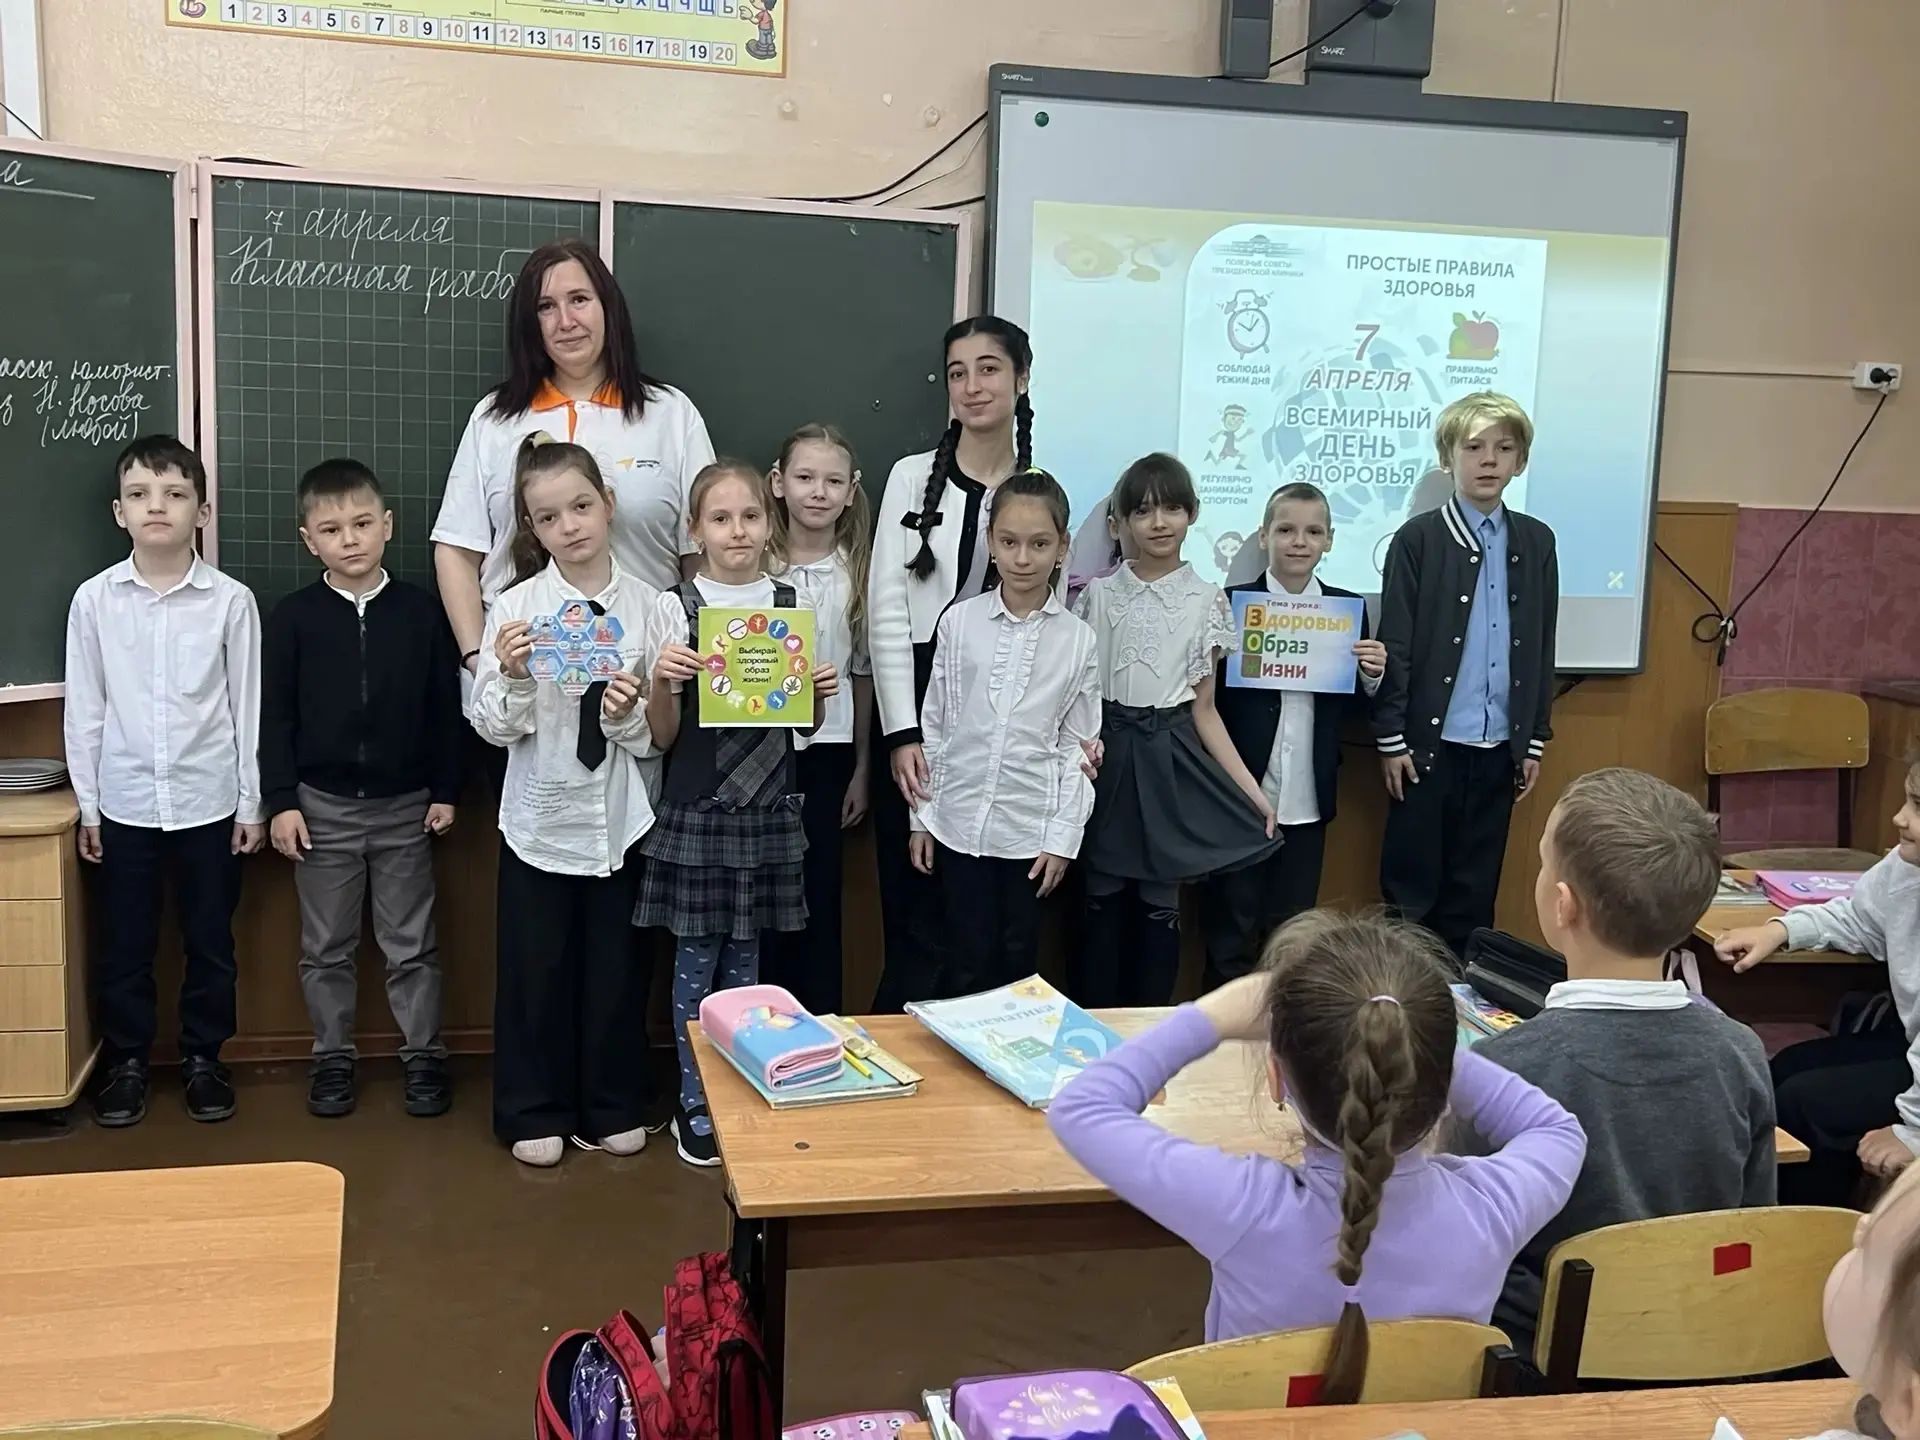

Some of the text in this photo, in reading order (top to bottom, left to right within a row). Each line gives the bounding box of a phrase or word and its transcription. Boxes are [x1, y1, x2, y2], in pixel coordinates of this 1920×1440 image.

[228, 4, 733, 61] 1 2 3 4 5 6 7 8 9 10 11 12 13 14 15 16 17 18 19 20
[265, 207, 454, 260] 7 апреля
[229, 235, 415, 292] Классная
[1347, 254, 1515, 278] ПРОСТЫЕ ПРАВИЛА
[1383, 279, 1475, 298] ЗДОРОВЬЯ
[1355, 324, 1380, 361] 7
[1217, 364, 1270, 374] СОБЛЮДАЙ
[1445, 365, 1498, 375] ПРАВИЛЬНО
[1216, 376, 1270, 386] РЕЖИМ ДНЯ
[1306, 369, 1412, 392] АПРЕЛЯ
[1450, 375, 1492, 385] ПИТАЙСЯ
[69, 380, 151, 416] Носова
[1286, 407, 1432, 429] ВСЕМИРНЫЙ
[1318, 434, 1396, 461] ДЕНЬ
[1295, 464, 1415, 485] ЗДОРОВЬЯ
[1203, 496, 1248, 505] СПОРТОМ
[1266, 600, 1322, 610] Тема урока:
[738, 646, 777, 655] Выбирай
[1246, 633, 1309, 658] Образ
[736, 657, 779, 665] здоровый
[744, 666, 770, 674] образ
[741, 676, 772, 684] жизни!
